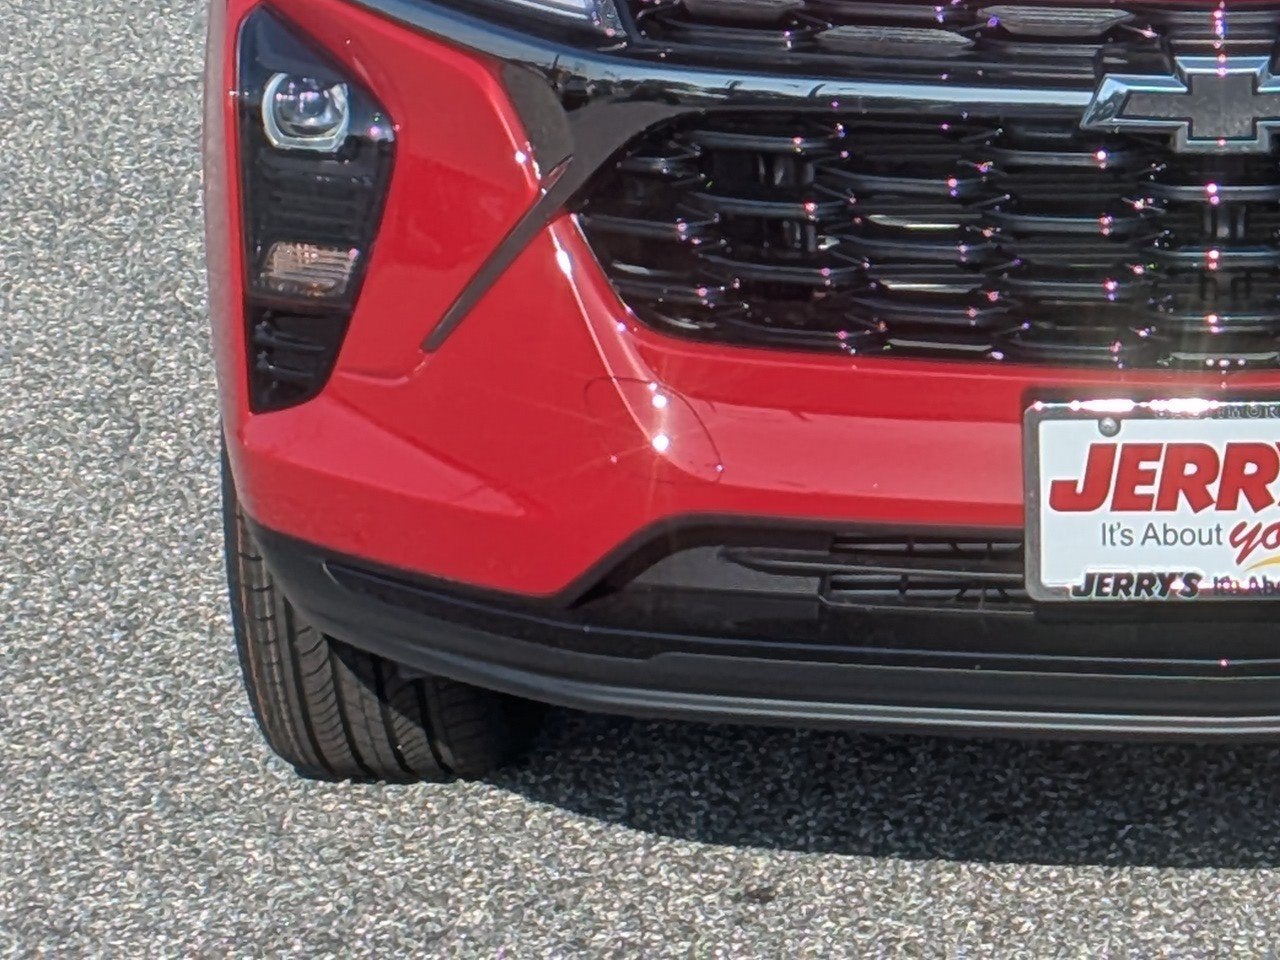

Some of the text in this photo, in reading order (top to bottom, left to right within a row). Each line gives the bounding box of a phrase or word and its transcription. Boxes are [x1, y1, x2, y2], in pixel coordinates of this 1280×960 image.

[1101, 522, 1134, 547] It's
[1143, 522, 1223, 547] About
[1071, 571, 1202, 599] JERRY'S
